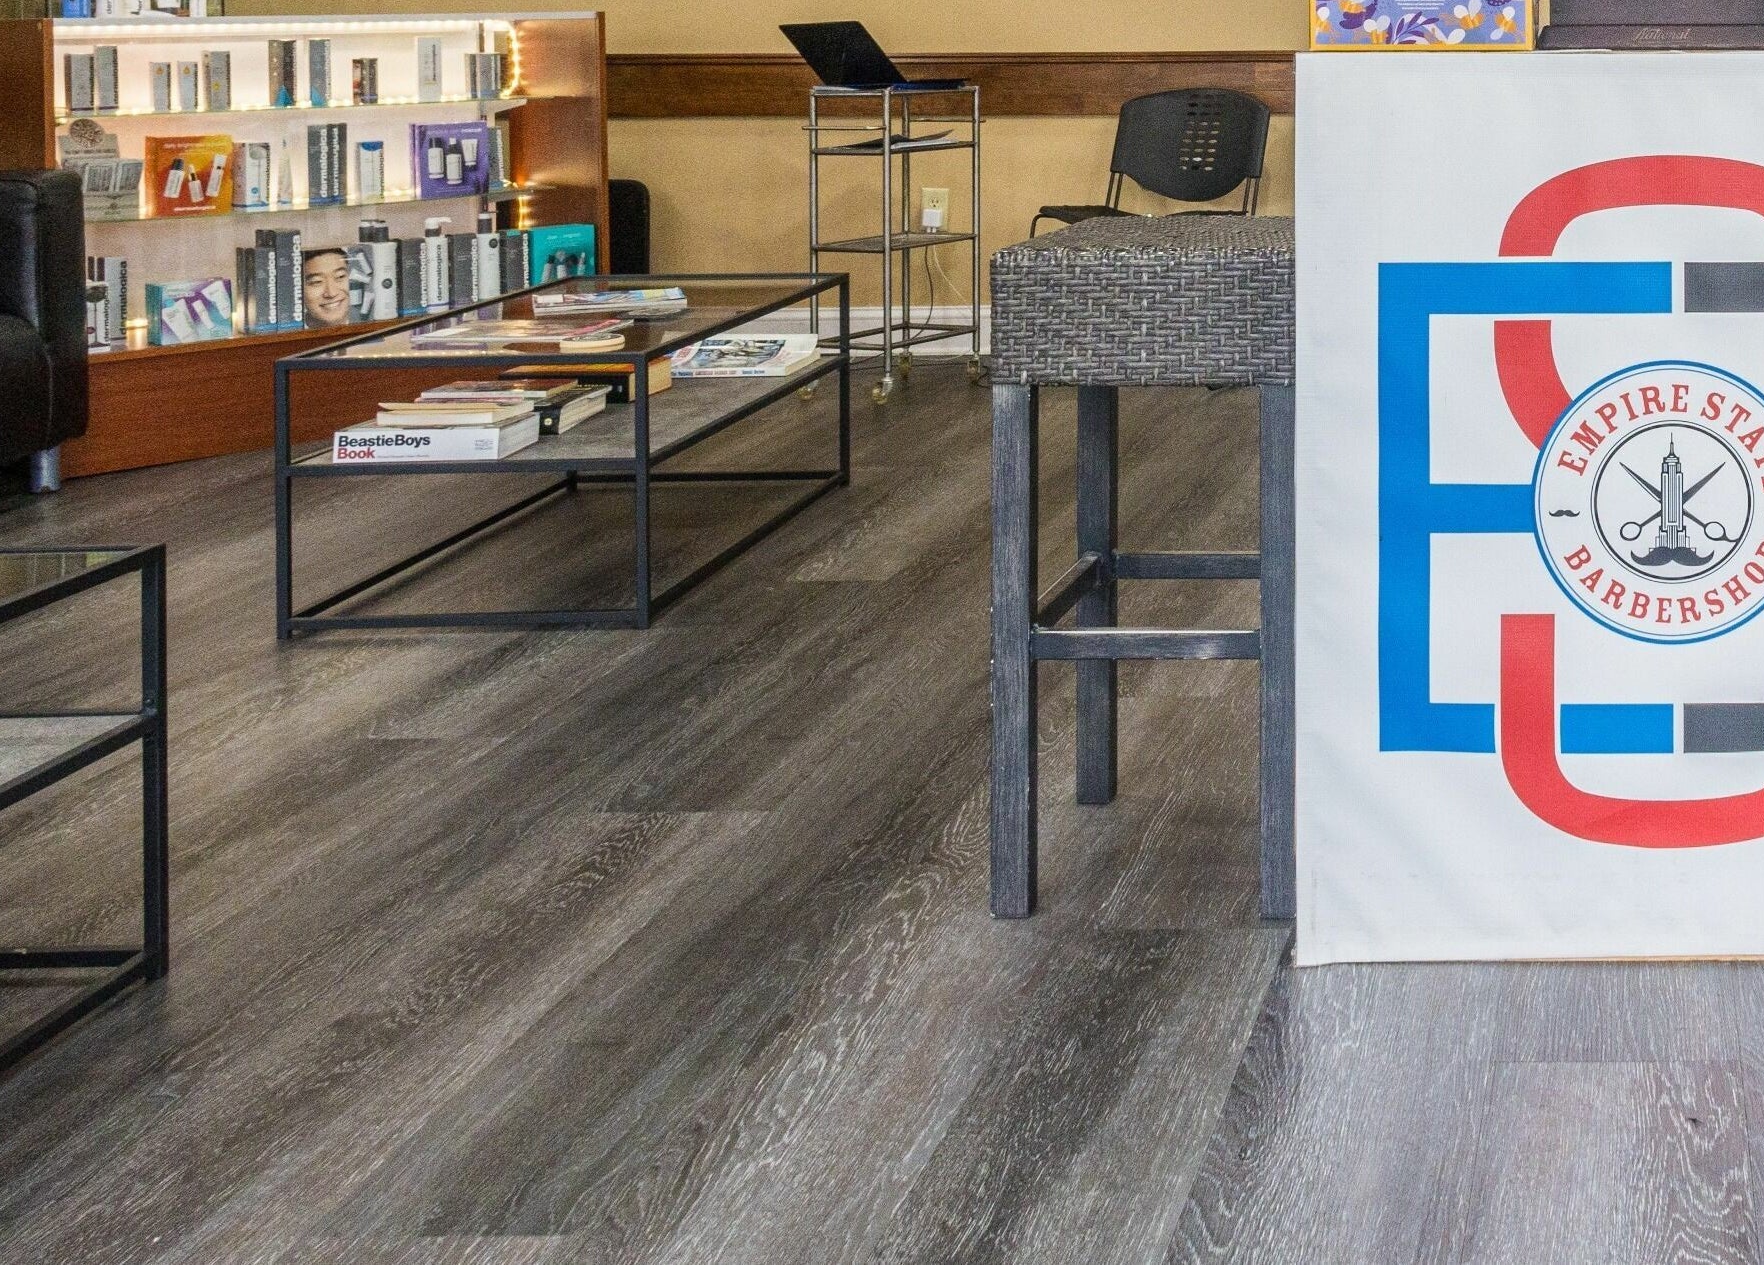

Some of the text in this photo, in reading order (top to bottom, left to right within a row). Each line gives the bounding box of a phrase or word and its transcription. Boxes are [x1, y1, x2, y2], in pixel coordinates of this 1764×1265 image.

[319, 128, 329, 198] dermalogica
[118, 260, 127, 335] dermalogica
[267, 251, 277, 324] dermalogica
[291, 234, 303, 322] dermalogica
[419, 242, 428, 308] dermalogica
[435, 244, 443, 302] dermalogica
[470, 238, 479, 302] dermalogica
[337, 448, 376, 460] Book
[1557, 384, 1690, 477] EMPIRE
